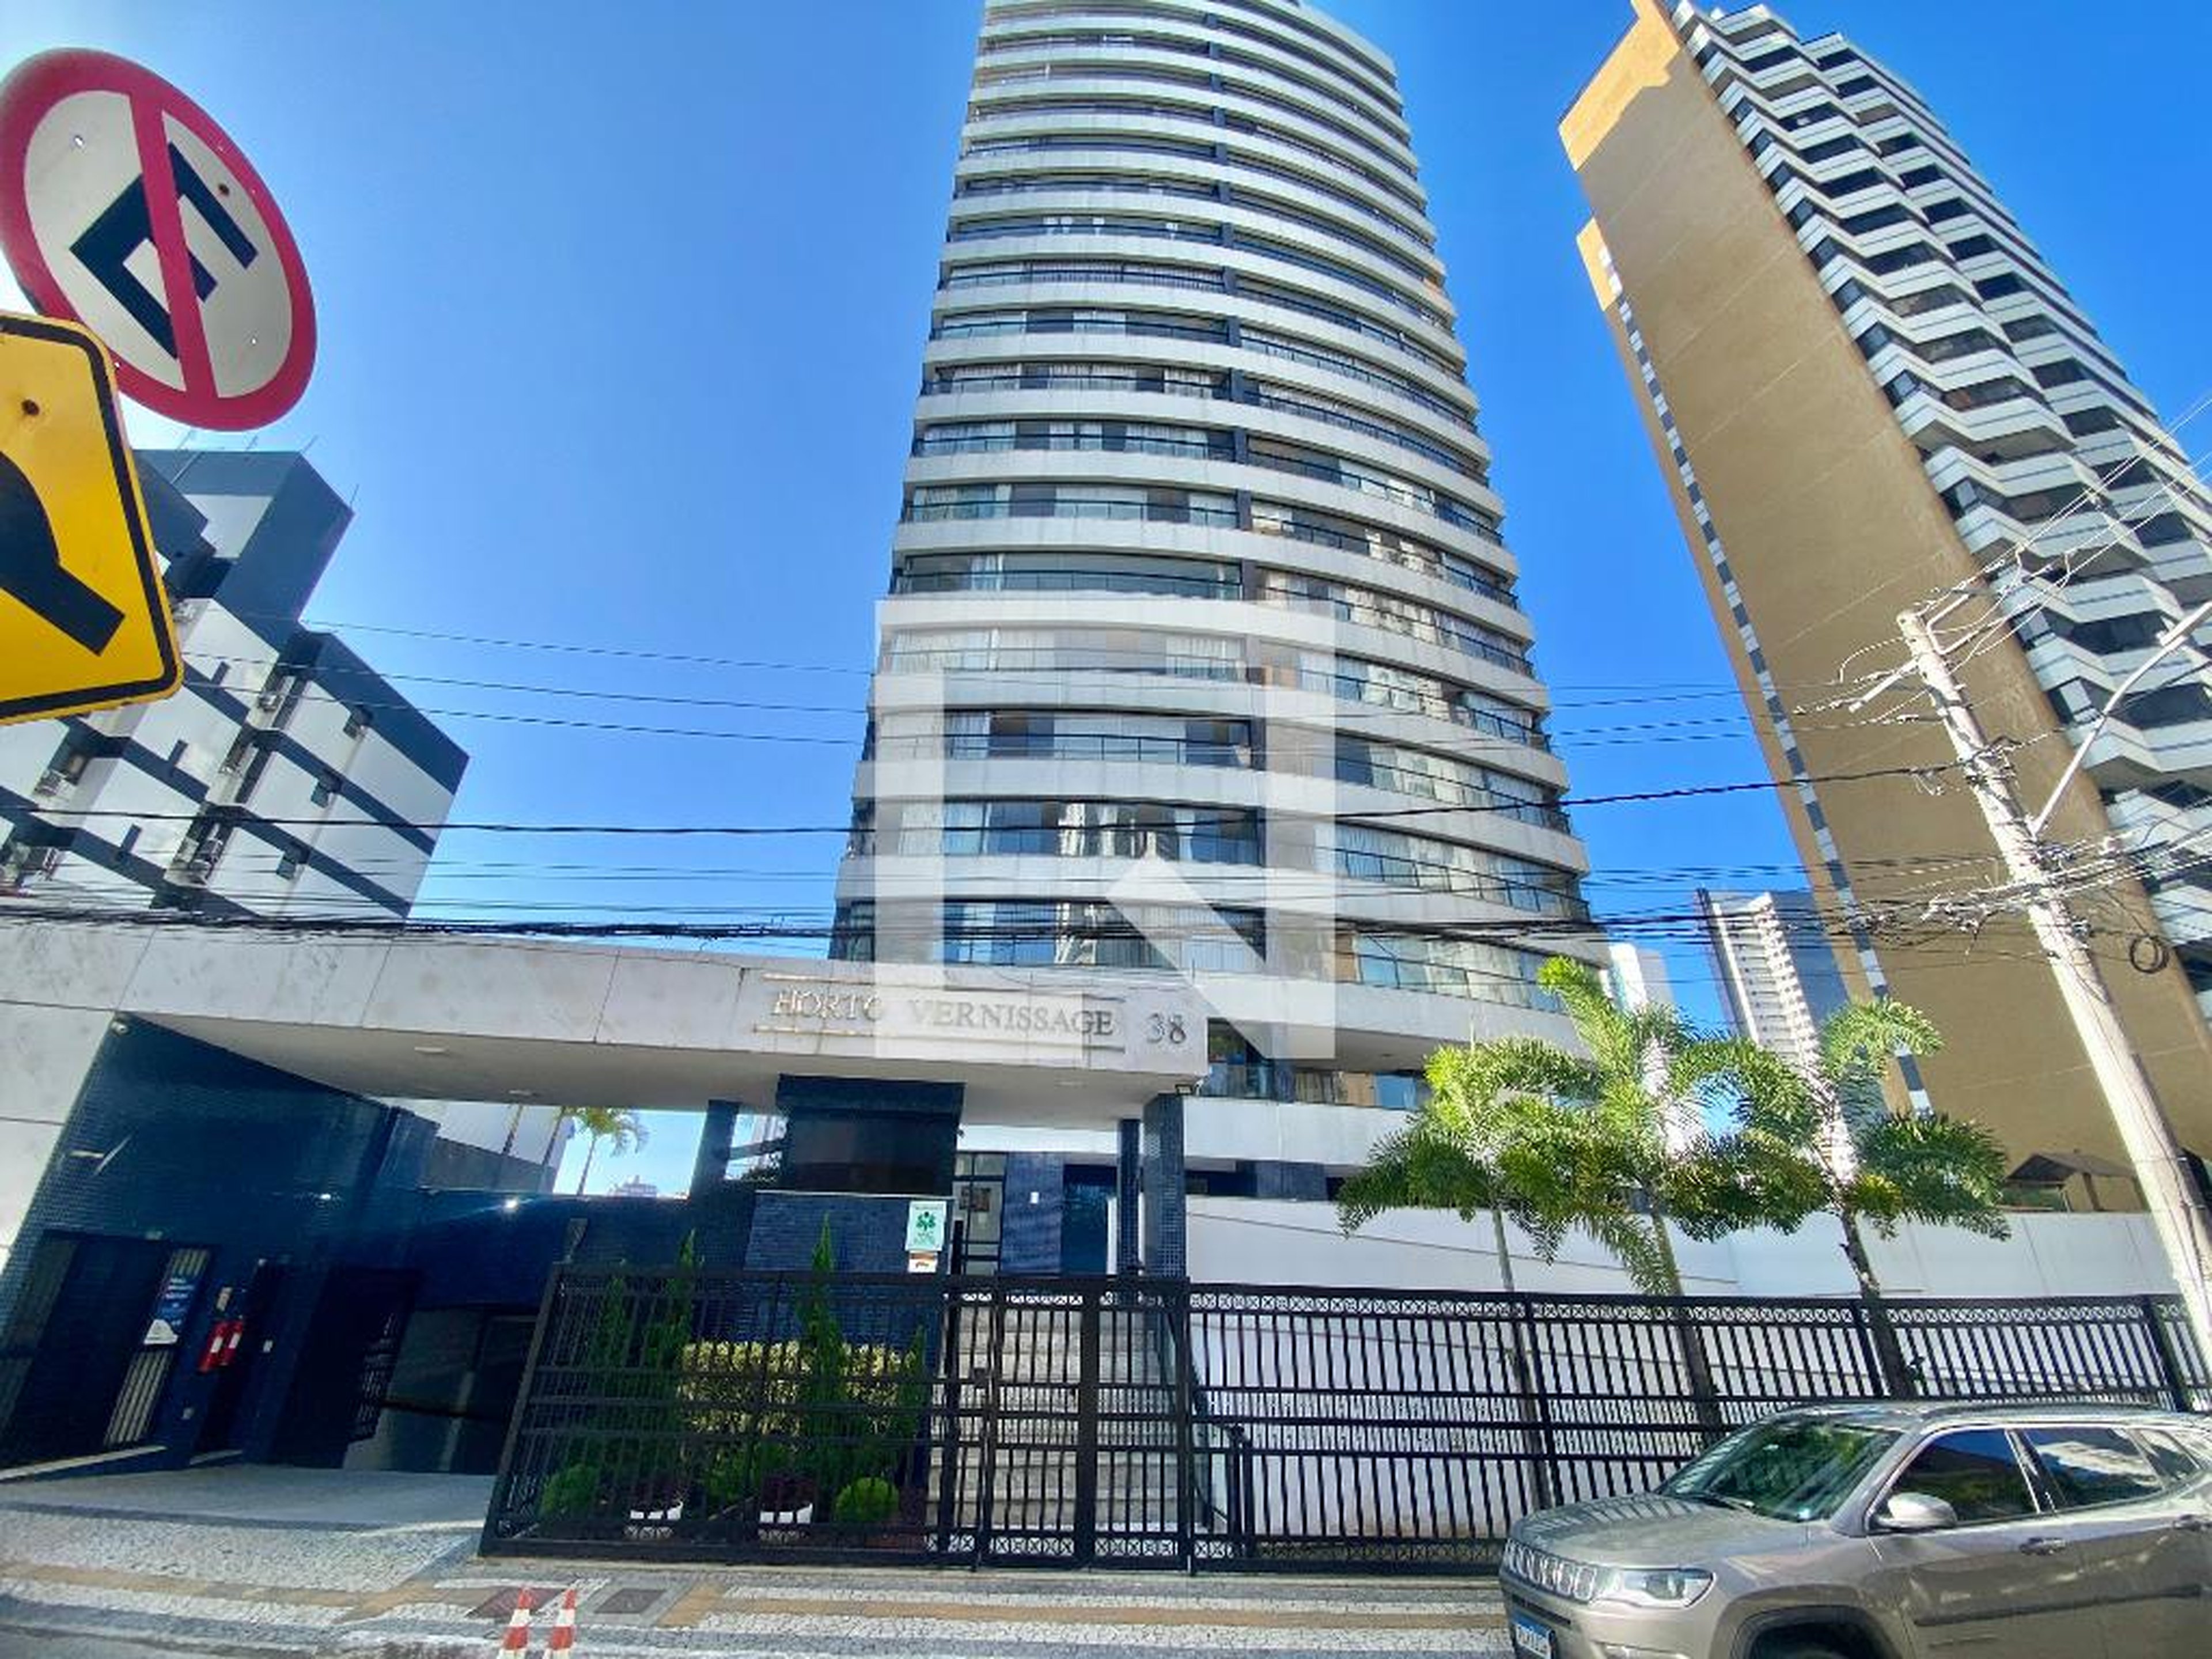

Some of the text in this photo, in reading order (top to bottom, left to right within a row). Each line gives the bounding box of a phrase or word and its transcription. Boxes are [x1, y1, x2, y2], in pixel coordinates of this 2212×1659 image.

[771, 988, 1187, 1044] HORTO VERNISSAGE 38
